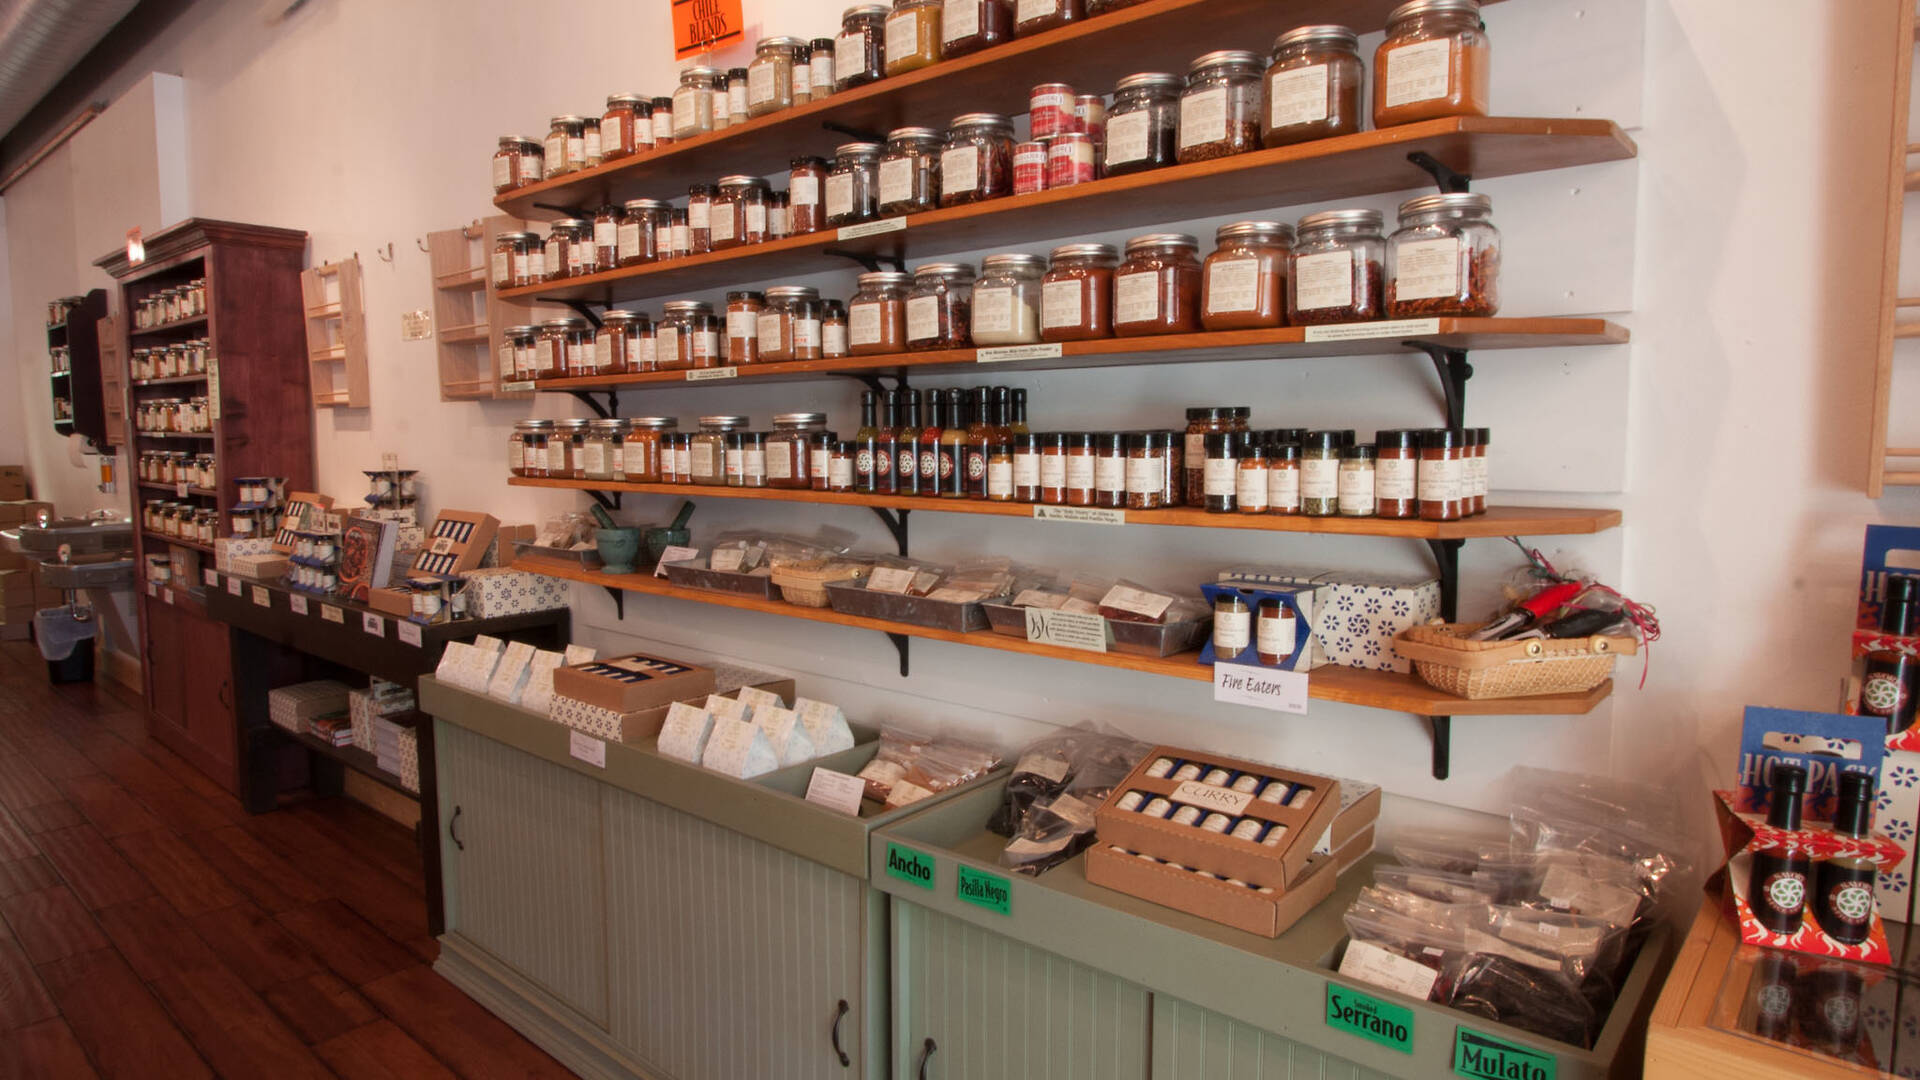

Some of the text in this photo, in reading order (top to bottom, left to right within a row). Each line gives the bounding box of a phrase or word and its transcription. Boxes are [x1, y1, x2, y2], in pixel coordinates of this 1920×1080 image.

[689, 12, 728, 44] BLENDS
[1222, 673, 1281, 696] Fire Eaters
[1806, 760, 1877, 796] PA
[1181, 784, 1246, 807] CURRY
[889, 848, 931, 881] Ancho
[960, 876, 1008, 905] Pasilla Negro
[1331, 994, 1408, 1042] Serrano
[1462, 1044, 1547, 1080] Mulato
